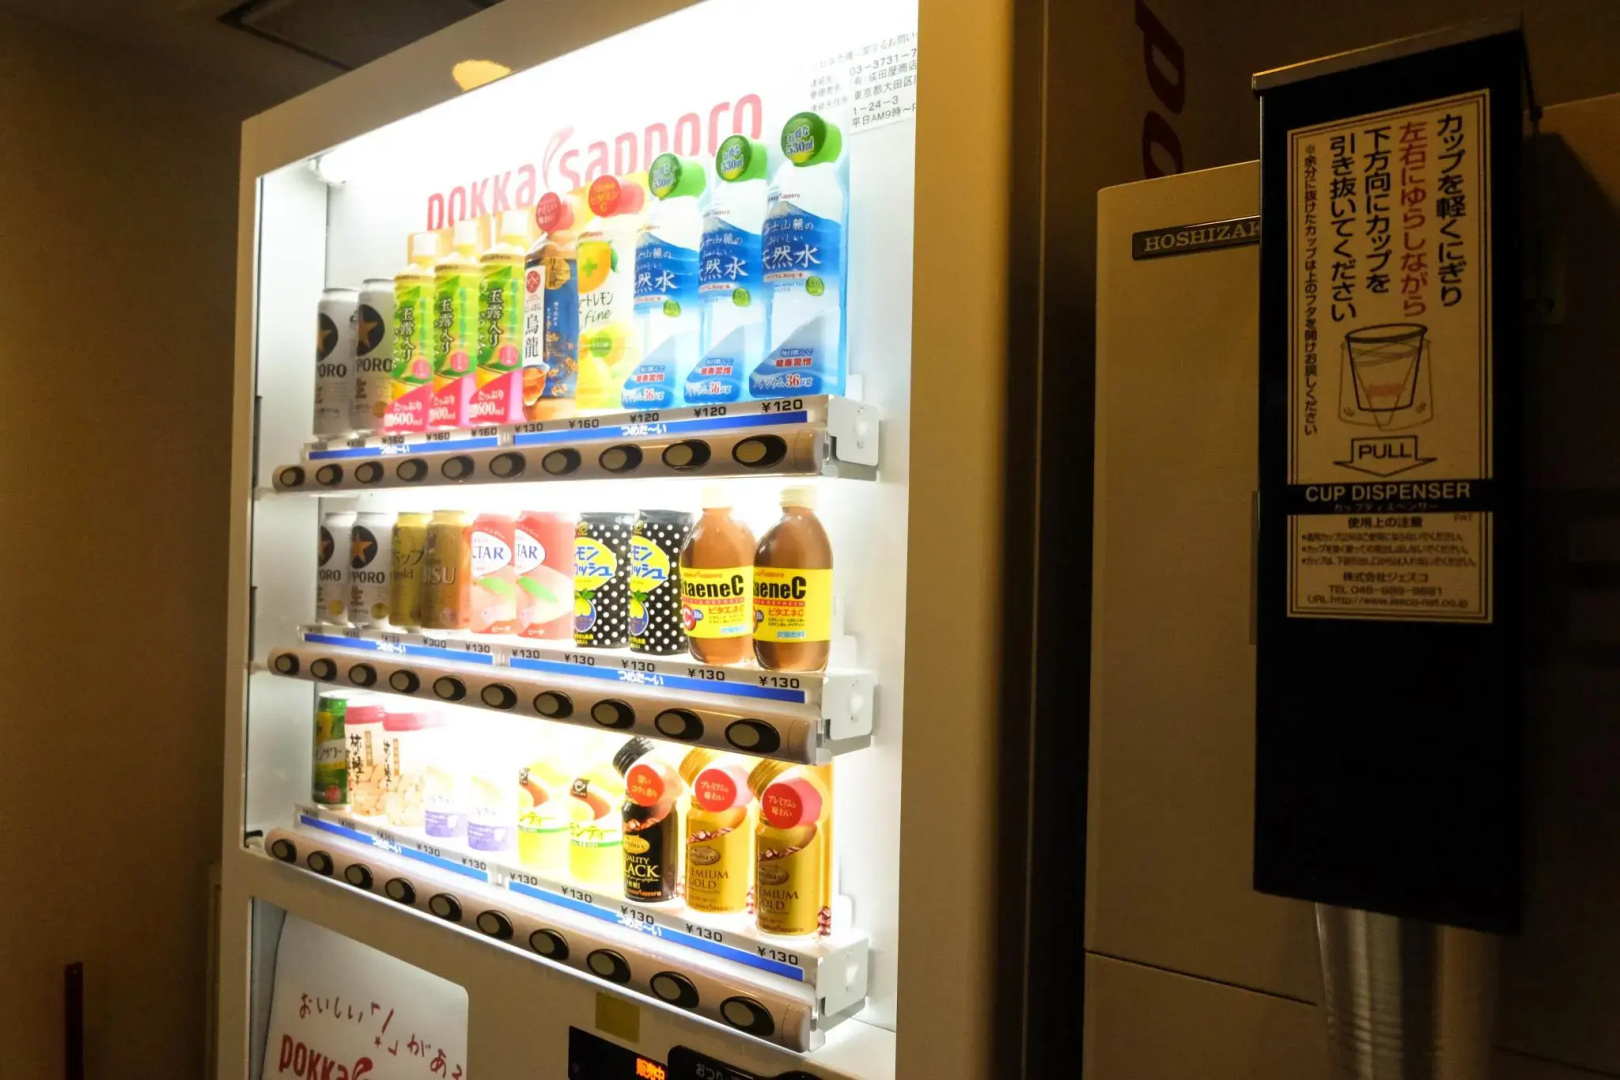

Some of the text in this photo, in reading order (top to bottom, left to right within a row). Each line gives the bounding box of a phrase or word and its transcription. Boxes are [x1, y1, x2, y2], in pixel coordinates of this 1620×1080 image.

[1330, 133, 1357, 322] 引き抜いてください
[1364, 125, 1392, 294] 下方向にカップを
[1399, 121, 1428, 318] 左右にゆらしながら
[1436, 113, 1467, 307] カップを軽くにぎり
[699, 257, 749, 281] 然水
[515, 422, 544, 433] ¥130
[569, 418, 600, 429] ¥160
[629, 412, 660, 424] ¥120
[693, 405, 727, 418] ¥120
[761, 398, 803, 413] ¥120
[1358, 442, 1412, 460] PULL
[1305, 481, 1471, 503] CUP DISPENSER
[466, 643, 491, 653] ¥130
[512, 648, 540, 659] ¥130
[565, 652, 595, 666] ¥130
[621, 658, 655, 673] ¥130
[687, 667, 725, 681] ¥130
[758, 675, 800, 689] ¥130
[416, 842, 441, 858] ¥130
[462, 857, 487, 871] ¥130
[509, 871, 538, 886] ¥130
[561, 885, 593, 904] ¥130
[620, 905, 655, 925] ¥130
[685, 922, 723, 943] ¥130
[757, 945, 799, 966] ¥130
